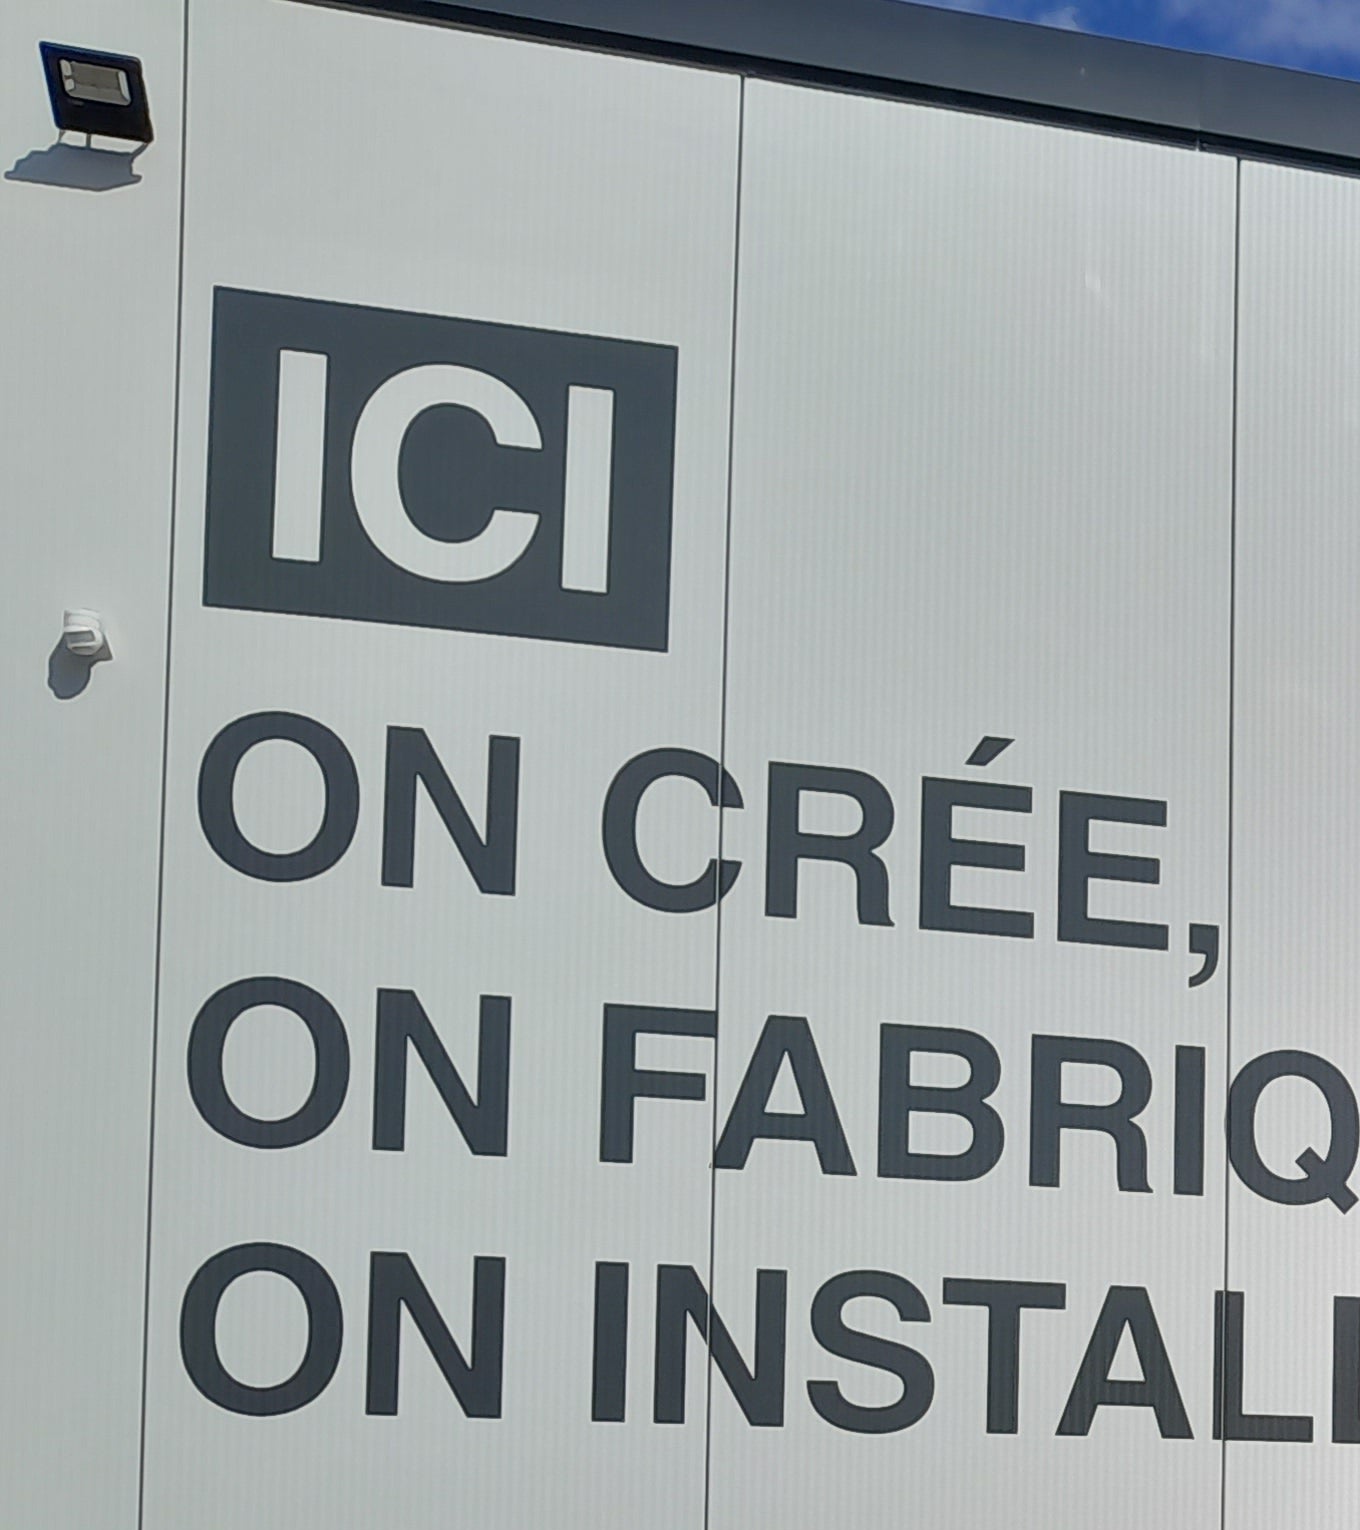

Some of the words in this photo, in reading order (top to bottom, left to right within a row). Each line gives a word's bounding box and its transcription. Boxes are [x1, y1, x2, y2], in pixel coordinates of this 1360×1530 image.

[272, 347, 614, 595] ICI
[196, 710, 520, 896] ON
[601, 735, 1220, 989] CRÉE,
[186, 975, 512, 1157] ON
[179, 1241, 506, 1418] ON
